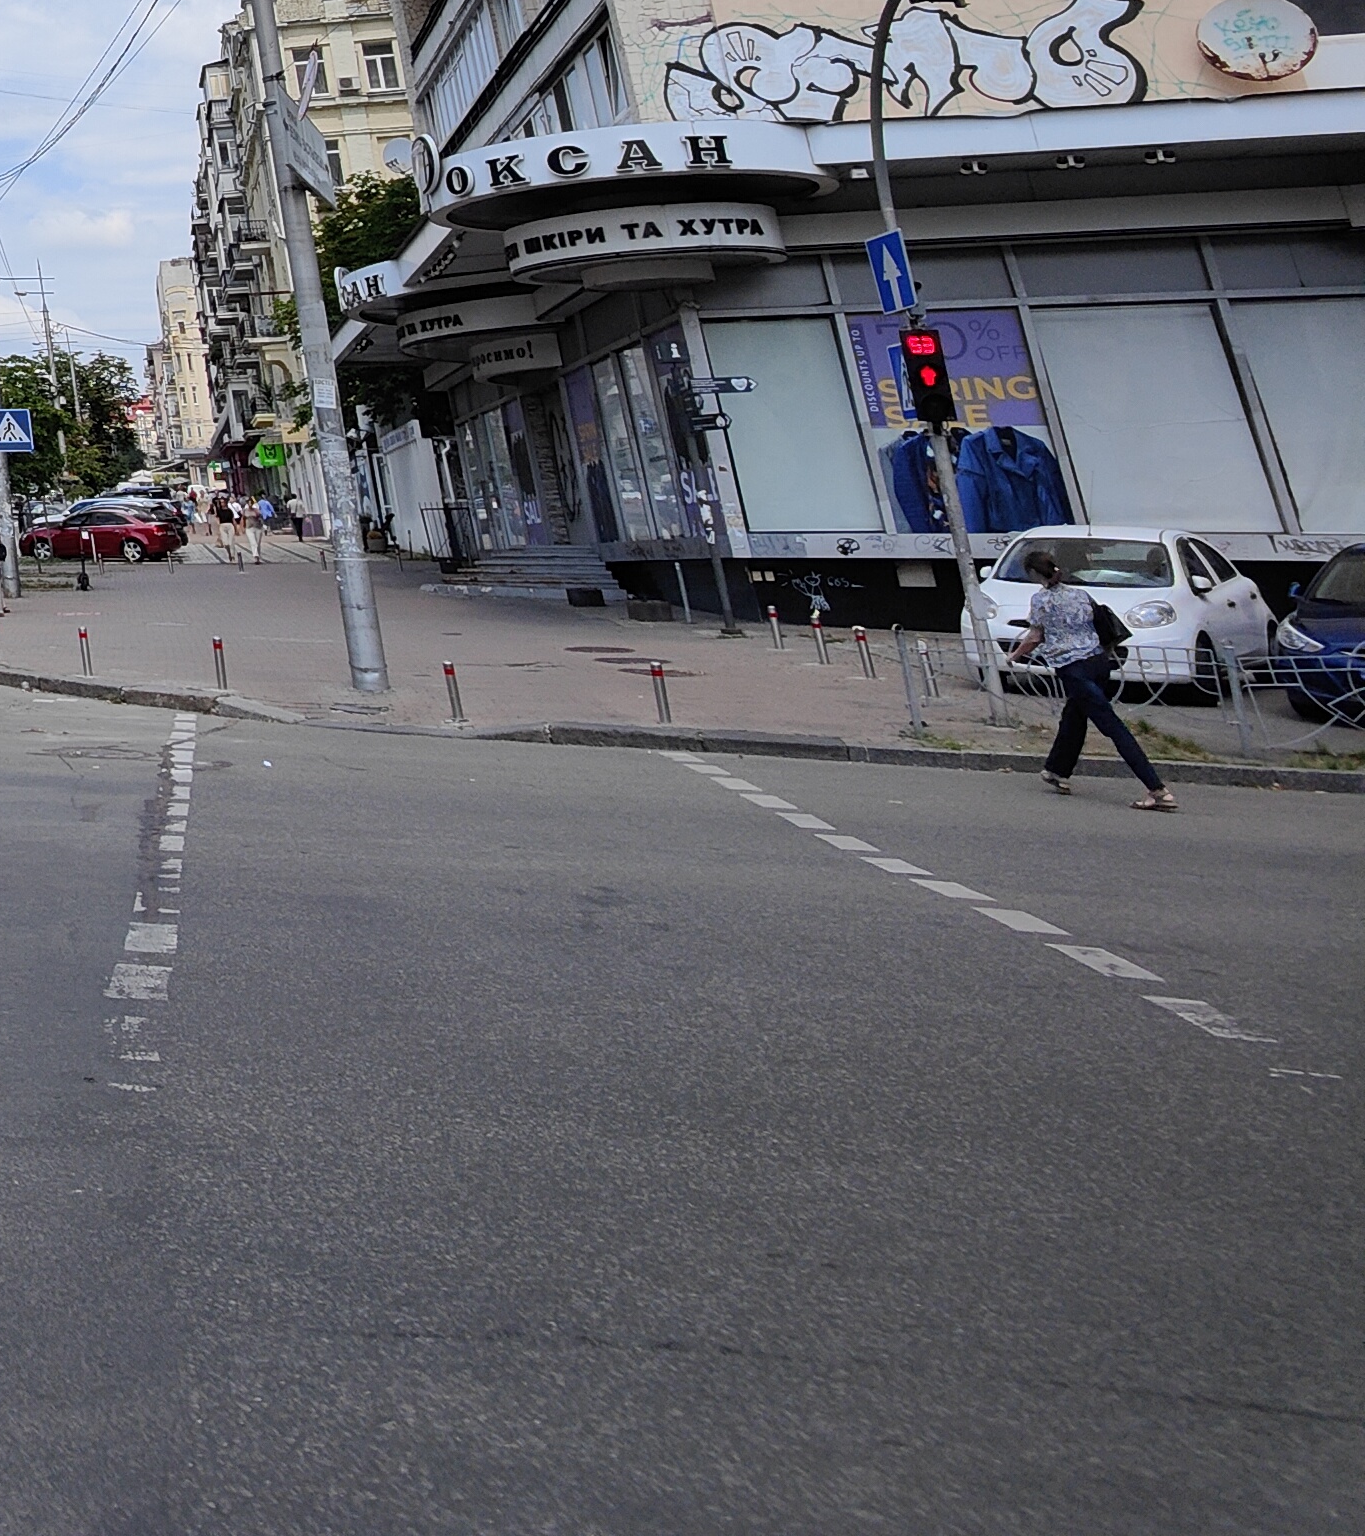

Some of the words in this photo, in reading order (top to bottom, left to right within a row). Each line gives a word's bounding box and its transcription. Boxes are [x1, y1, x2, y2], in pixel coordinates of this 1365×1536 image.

[523, 226, 605, 255] ШКІРИ
[620, 221, 664, 240] ТА
[677, 218, 765, 237] ХУТРА
[342, 273, 386, 307] САН
[851, 329, 861, 341] TO
[856, 341, 866, 357] UP
[861, 358, 879, 413] DISCOUNTS
